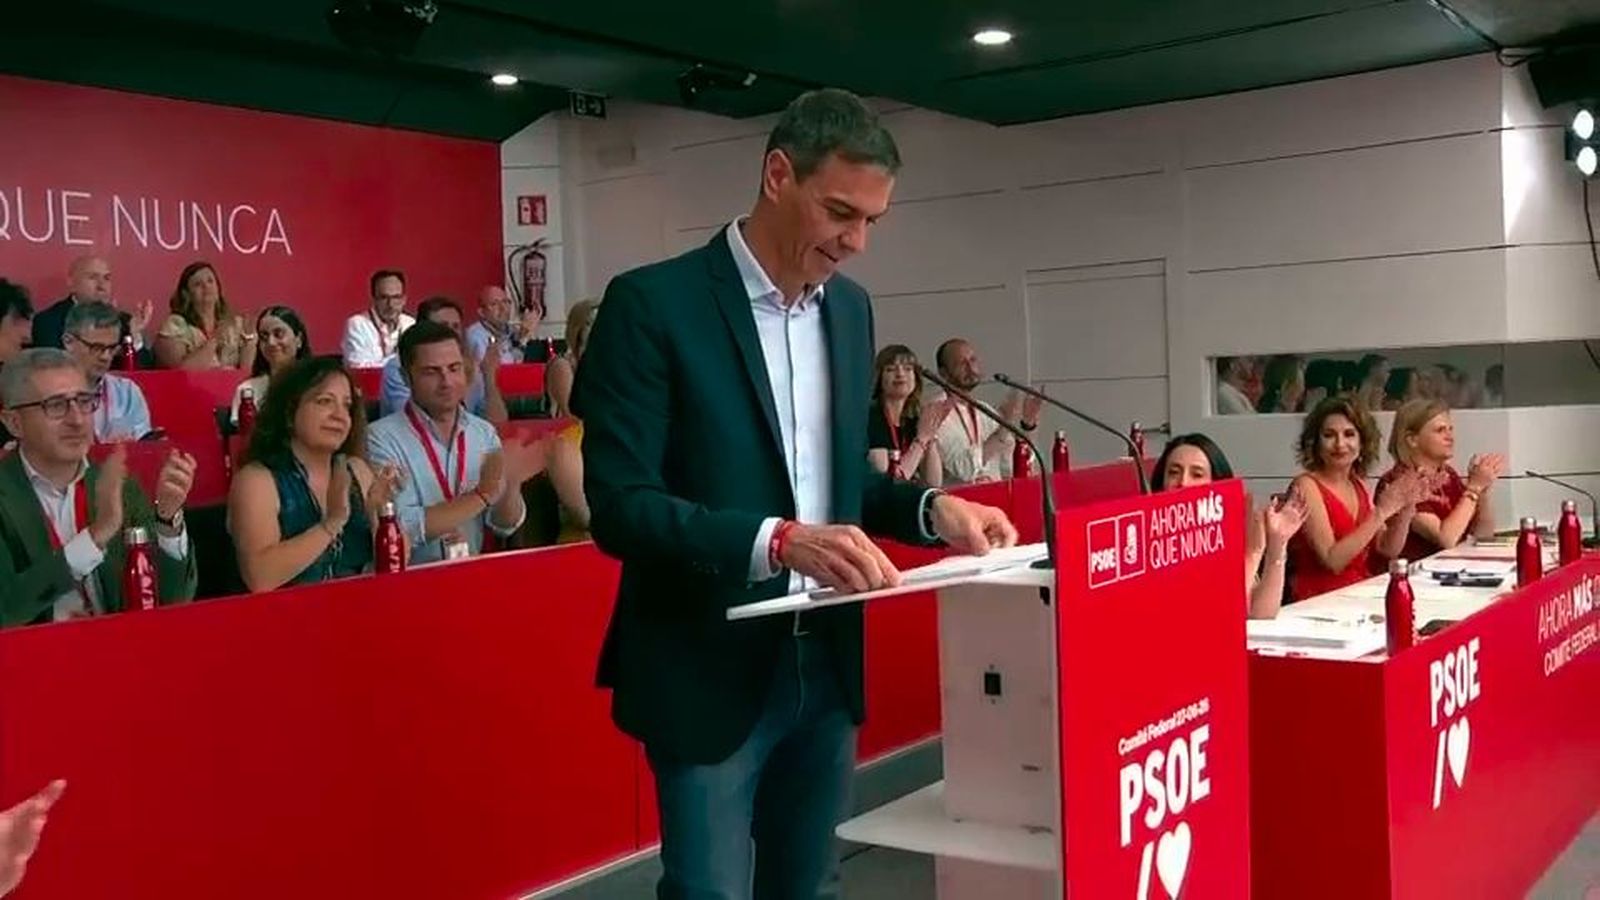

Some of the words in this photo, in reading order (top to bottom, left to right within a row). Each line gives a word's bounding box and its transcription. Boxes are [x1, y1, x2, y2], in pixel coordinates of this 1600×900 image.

[113, 194, 292, 255] NUNCA
[1151, 502, 1195, 536] AHORA
[1196, 490, 1224, 526] MÁS
[1091, 547, 1116, 574] PSOE
[1150, 535, 1178, 569] QUE
[1180, 525, 1225, 561] NUNCA
[1538, 589, 1573, 644] AHORA
[1573, 573, 1593, 620] MÁS
[1429, 636, 1481, 728] PSOE
[1119, 723, 1211, 848] PSOE
